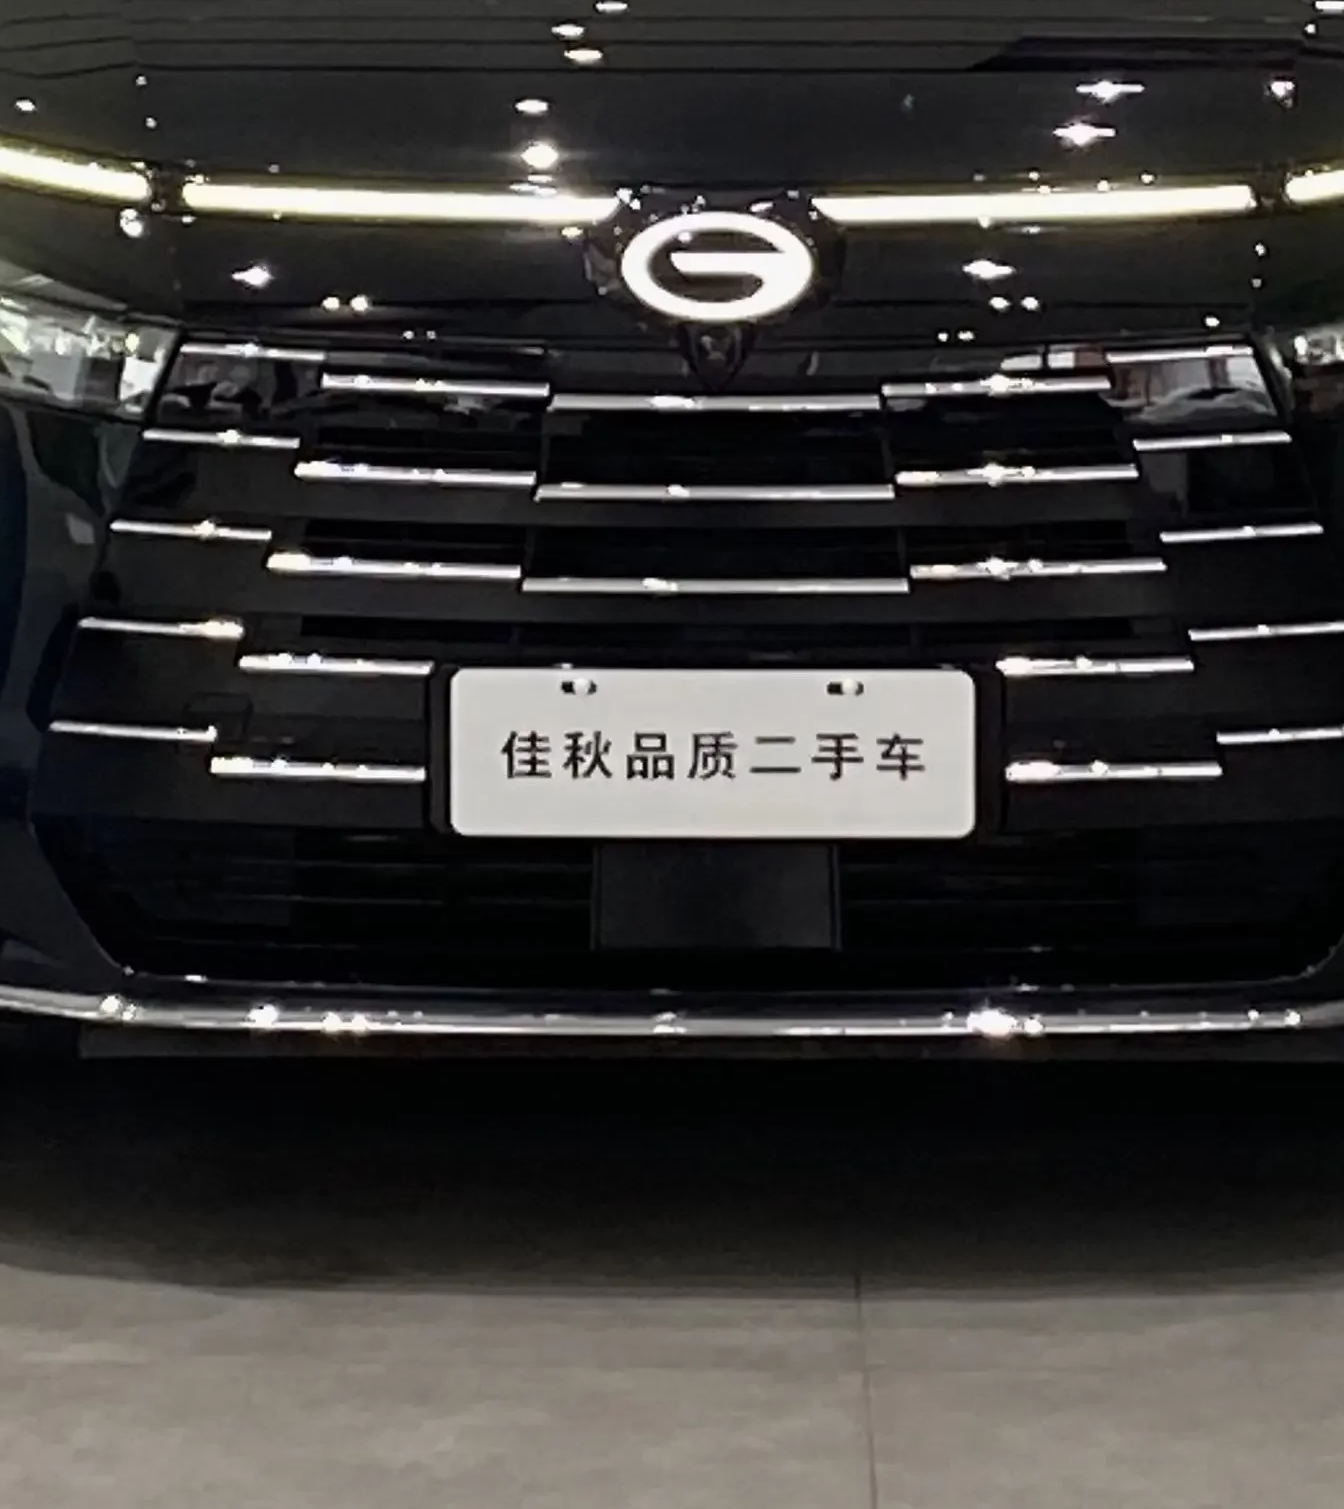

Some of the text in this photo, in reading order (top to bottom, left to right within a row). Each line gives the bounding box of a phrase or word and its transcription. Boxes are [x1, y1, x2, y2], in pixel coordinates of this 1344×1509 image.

[500, 729, 927, 782] 佳秋品质二手车
